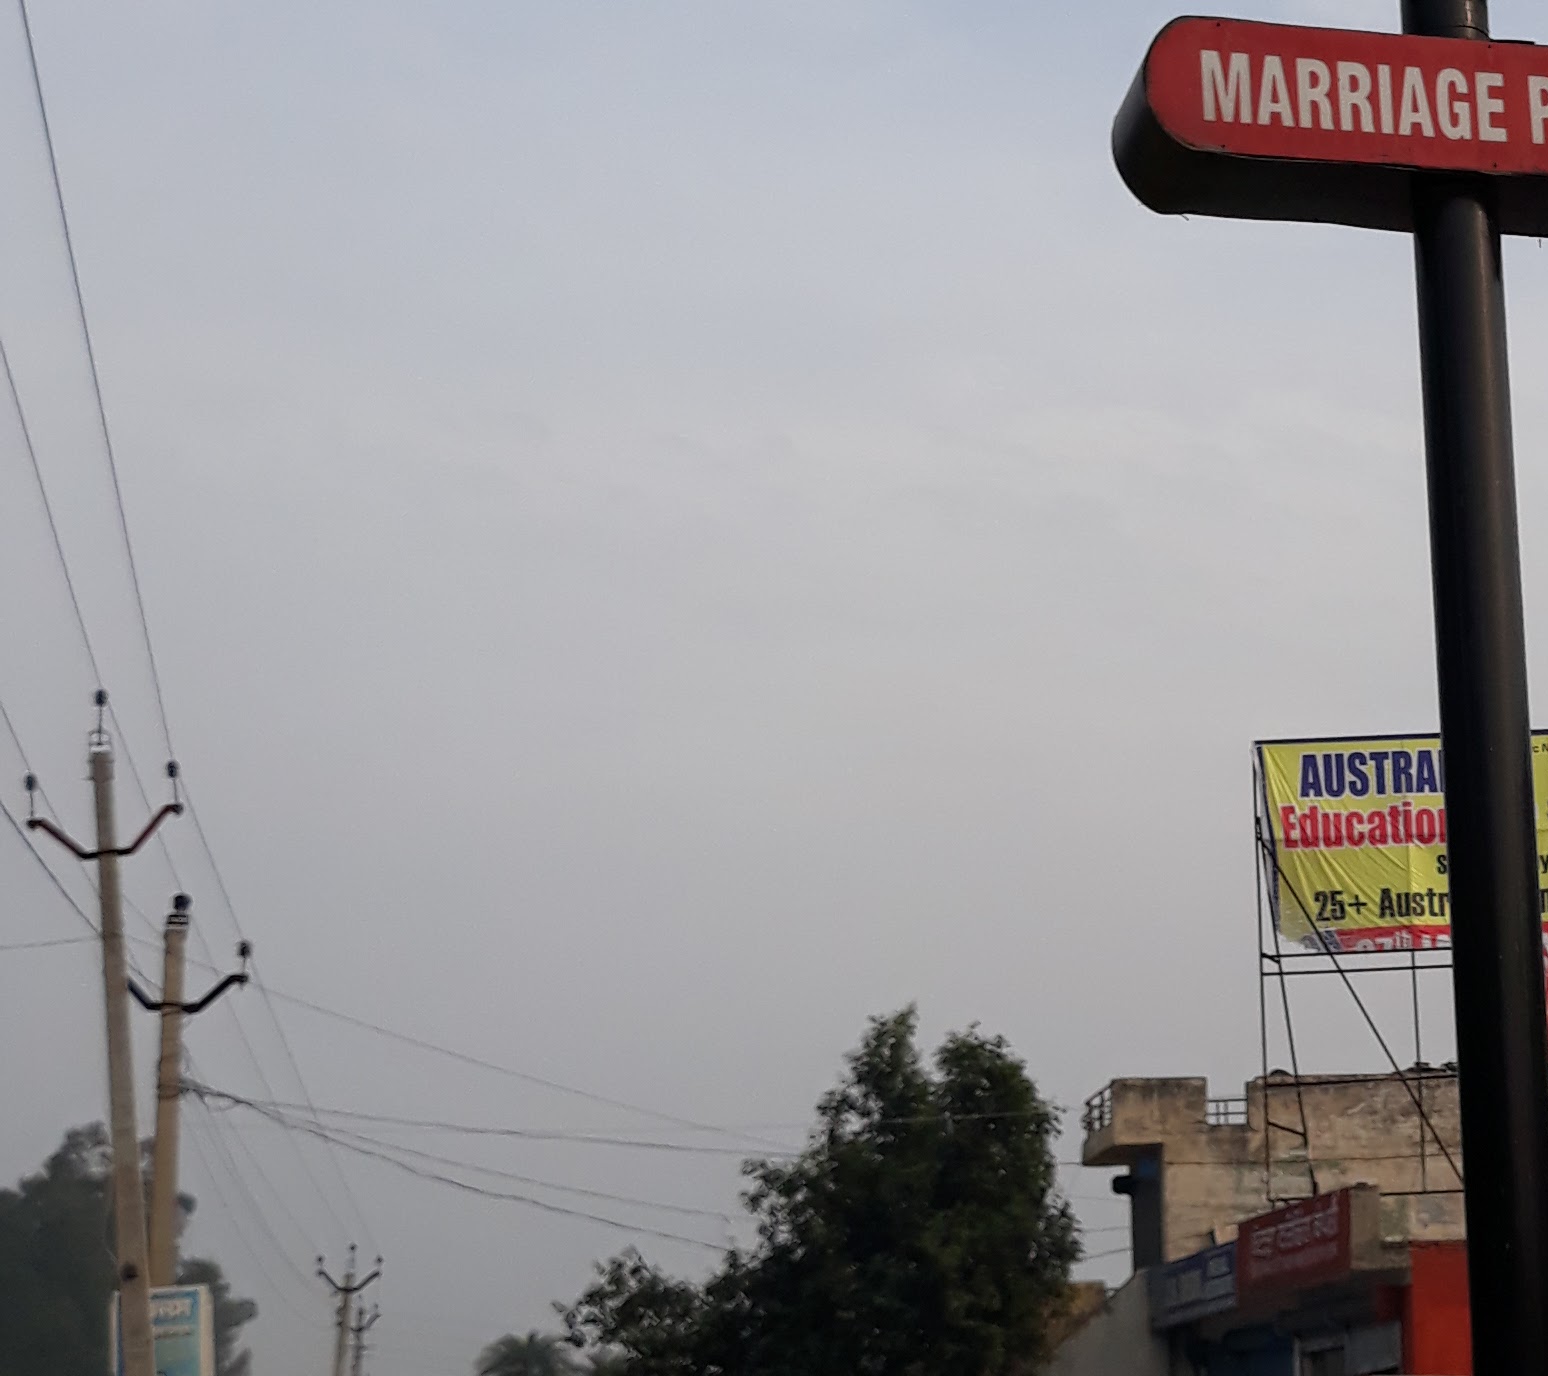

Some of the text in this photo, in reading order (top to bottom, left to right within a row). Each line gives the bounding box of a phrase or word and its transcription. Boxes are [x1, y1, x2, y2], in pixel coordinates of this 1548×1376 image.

[1199, 48, 1507, 144] MARRIAGE
[1300, 749, 1445, 798] AUSTRA
[1314, 890, 1367, 922] 25+
[1379, 888, 1450, 918] Austr
